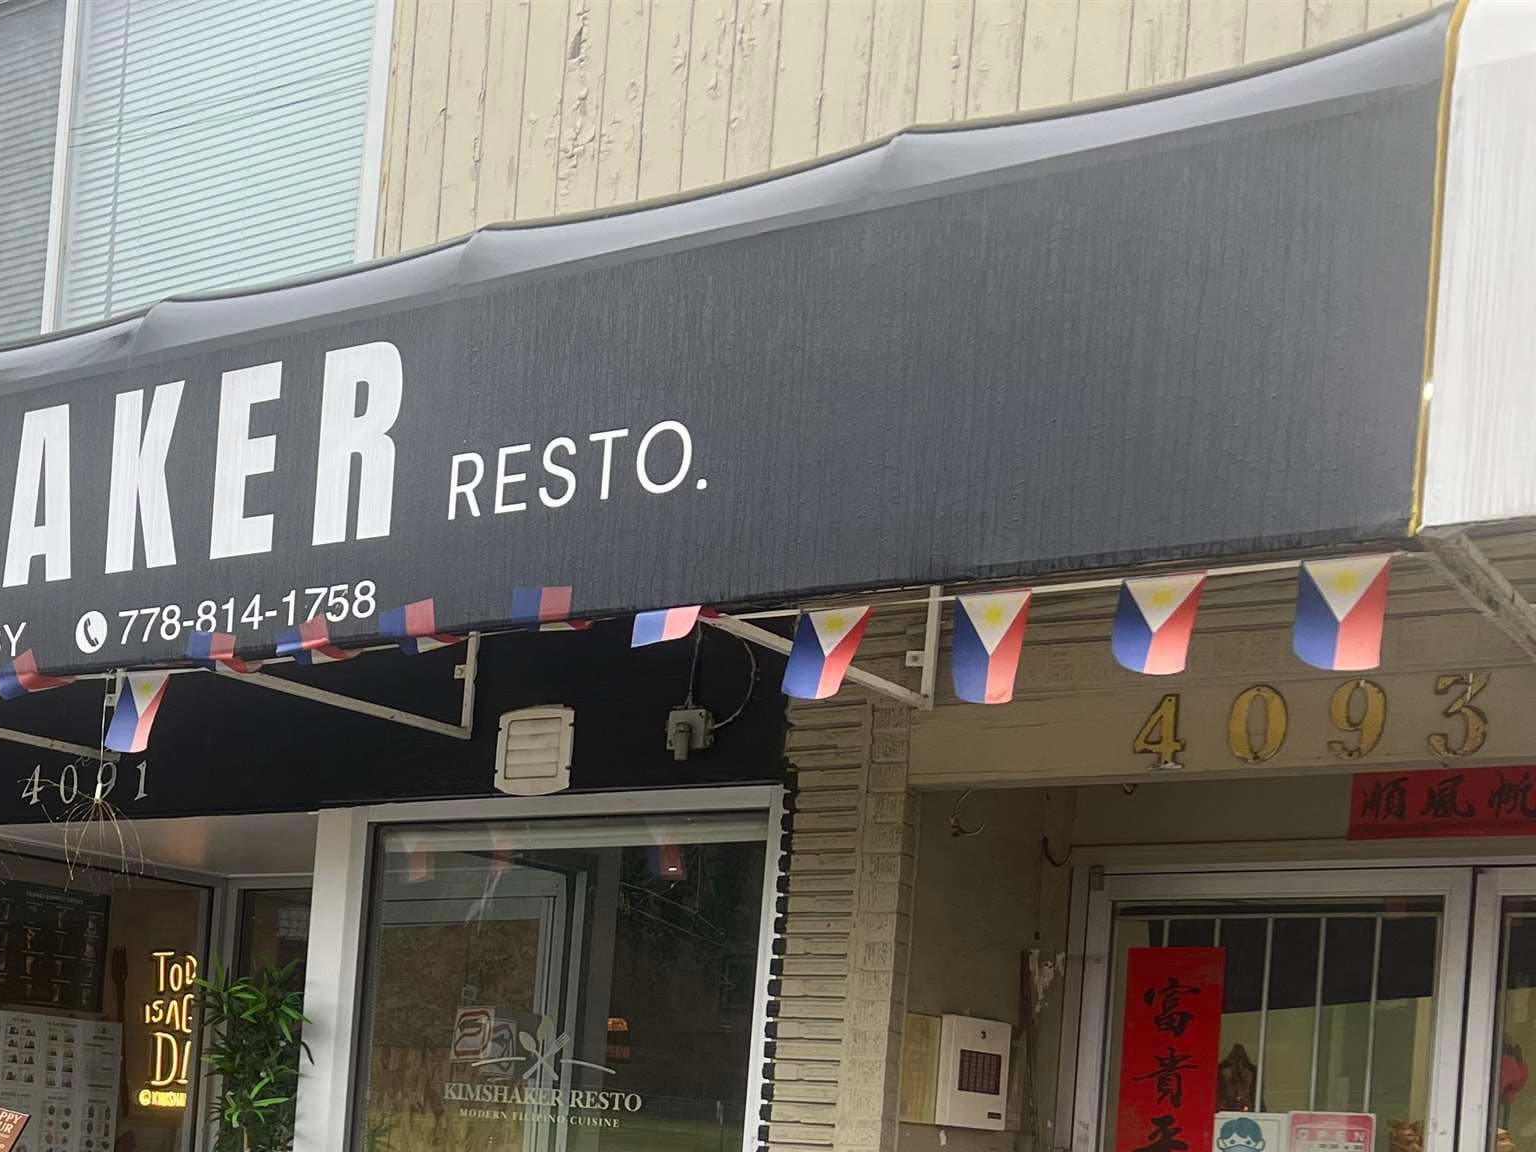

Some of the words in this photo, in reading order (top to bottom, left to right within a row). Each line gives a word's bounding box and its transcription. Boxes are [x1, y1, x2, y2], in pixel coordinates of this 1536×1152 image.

[447, 420, 710, 521] RESTO.
[118, 579, 378, 645] 778-814-1758
[1132, 672, 1491, 770] 4093
[21, 760, 150, 806] 4091
[443, 1082, 565, 1106] KIMSHAKER
[570, 1089, 642, 1112] RESTO
[459, 1108, 507, 1120] MODERN
[512, 1111, 565, 1124] FILIPINO
[570, 1116, 620, 1128] CUISINE
